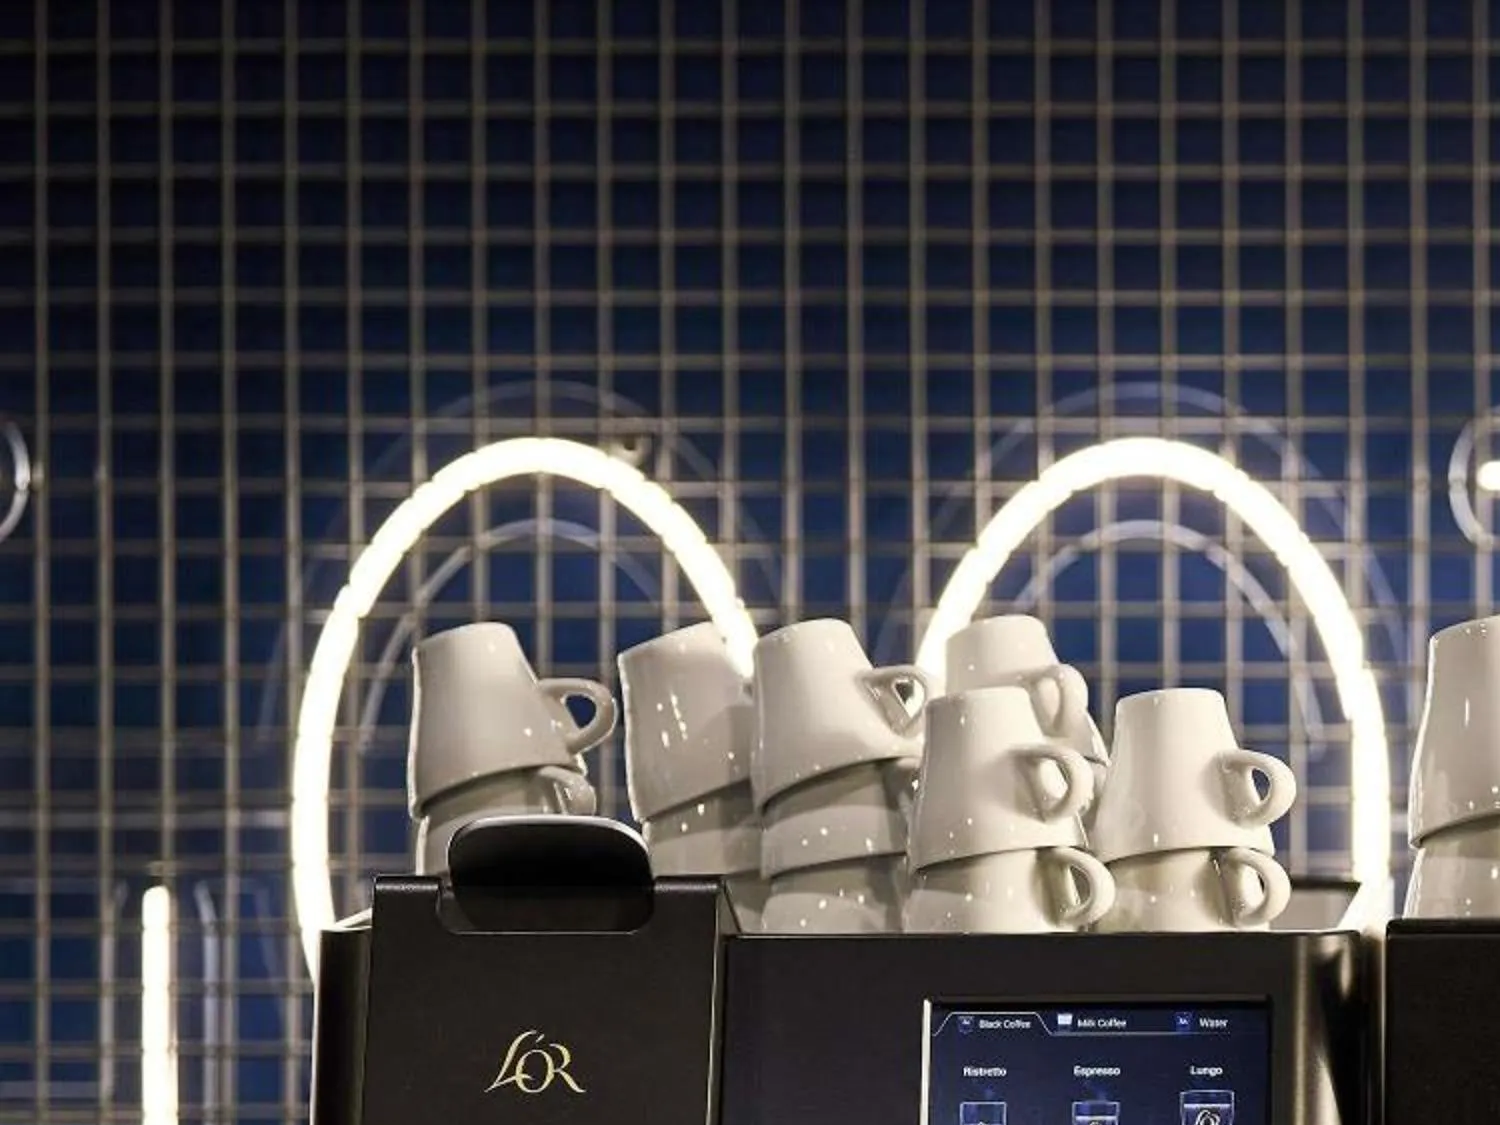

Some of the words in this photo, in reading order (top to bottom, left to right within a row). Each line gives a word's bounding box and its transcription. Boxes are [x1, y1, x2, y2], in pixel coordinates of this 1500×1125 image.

[1003, 1019, 1031, 1029] Coffee
[1097, 1018, 1127, 1029] Coffee
[1199, 1018, 1229, 1028] Water
[963, 1066, 1007, 1077] Ristretto
[1073, 1065, 1121, 1077] Espresso
[1190, 1065, 1223, 1077] Lungo
